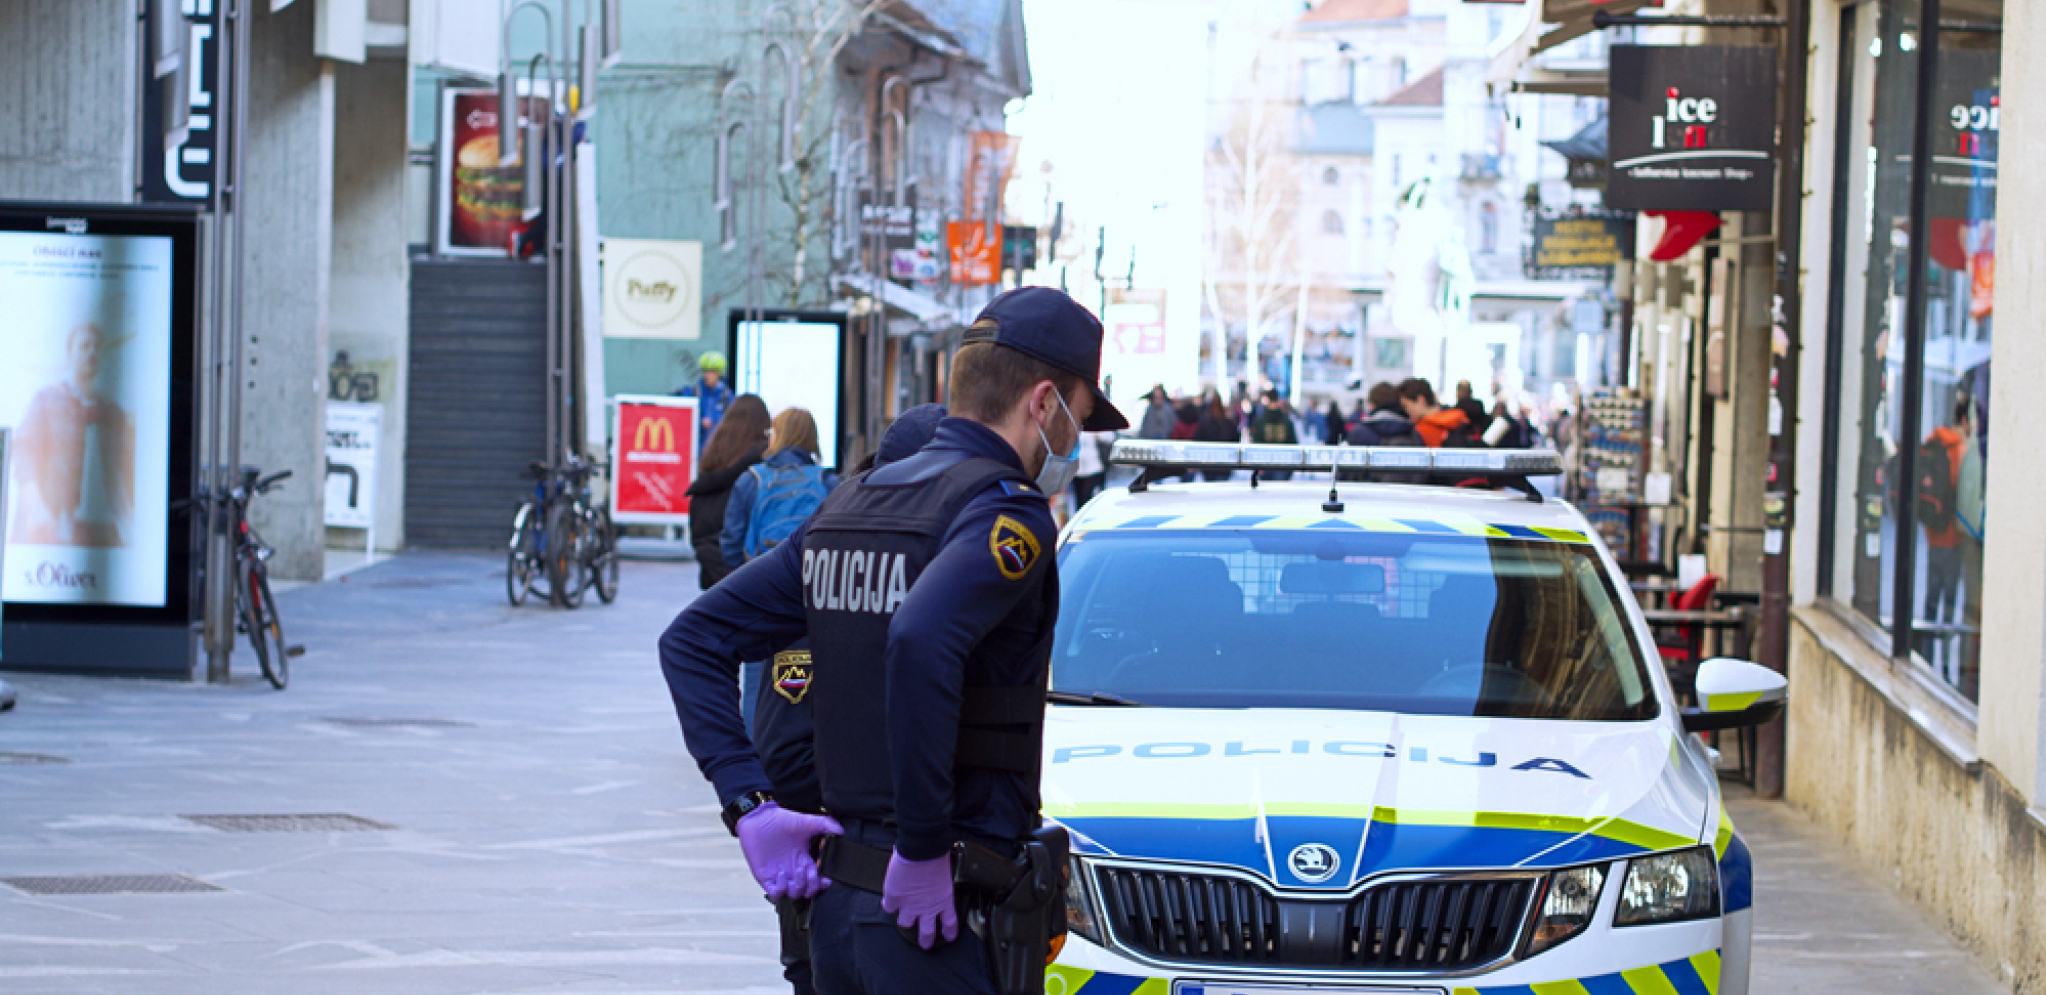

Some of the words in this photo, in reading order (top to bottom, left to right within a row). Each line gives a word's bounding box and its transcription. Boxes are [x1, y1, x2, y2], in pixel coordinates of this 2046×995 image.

[1667, 86, 1718, 123] ice
[802, 548, 909, 614] POLICIJA
[1052, 740, 1593, 780] POLICIJA
